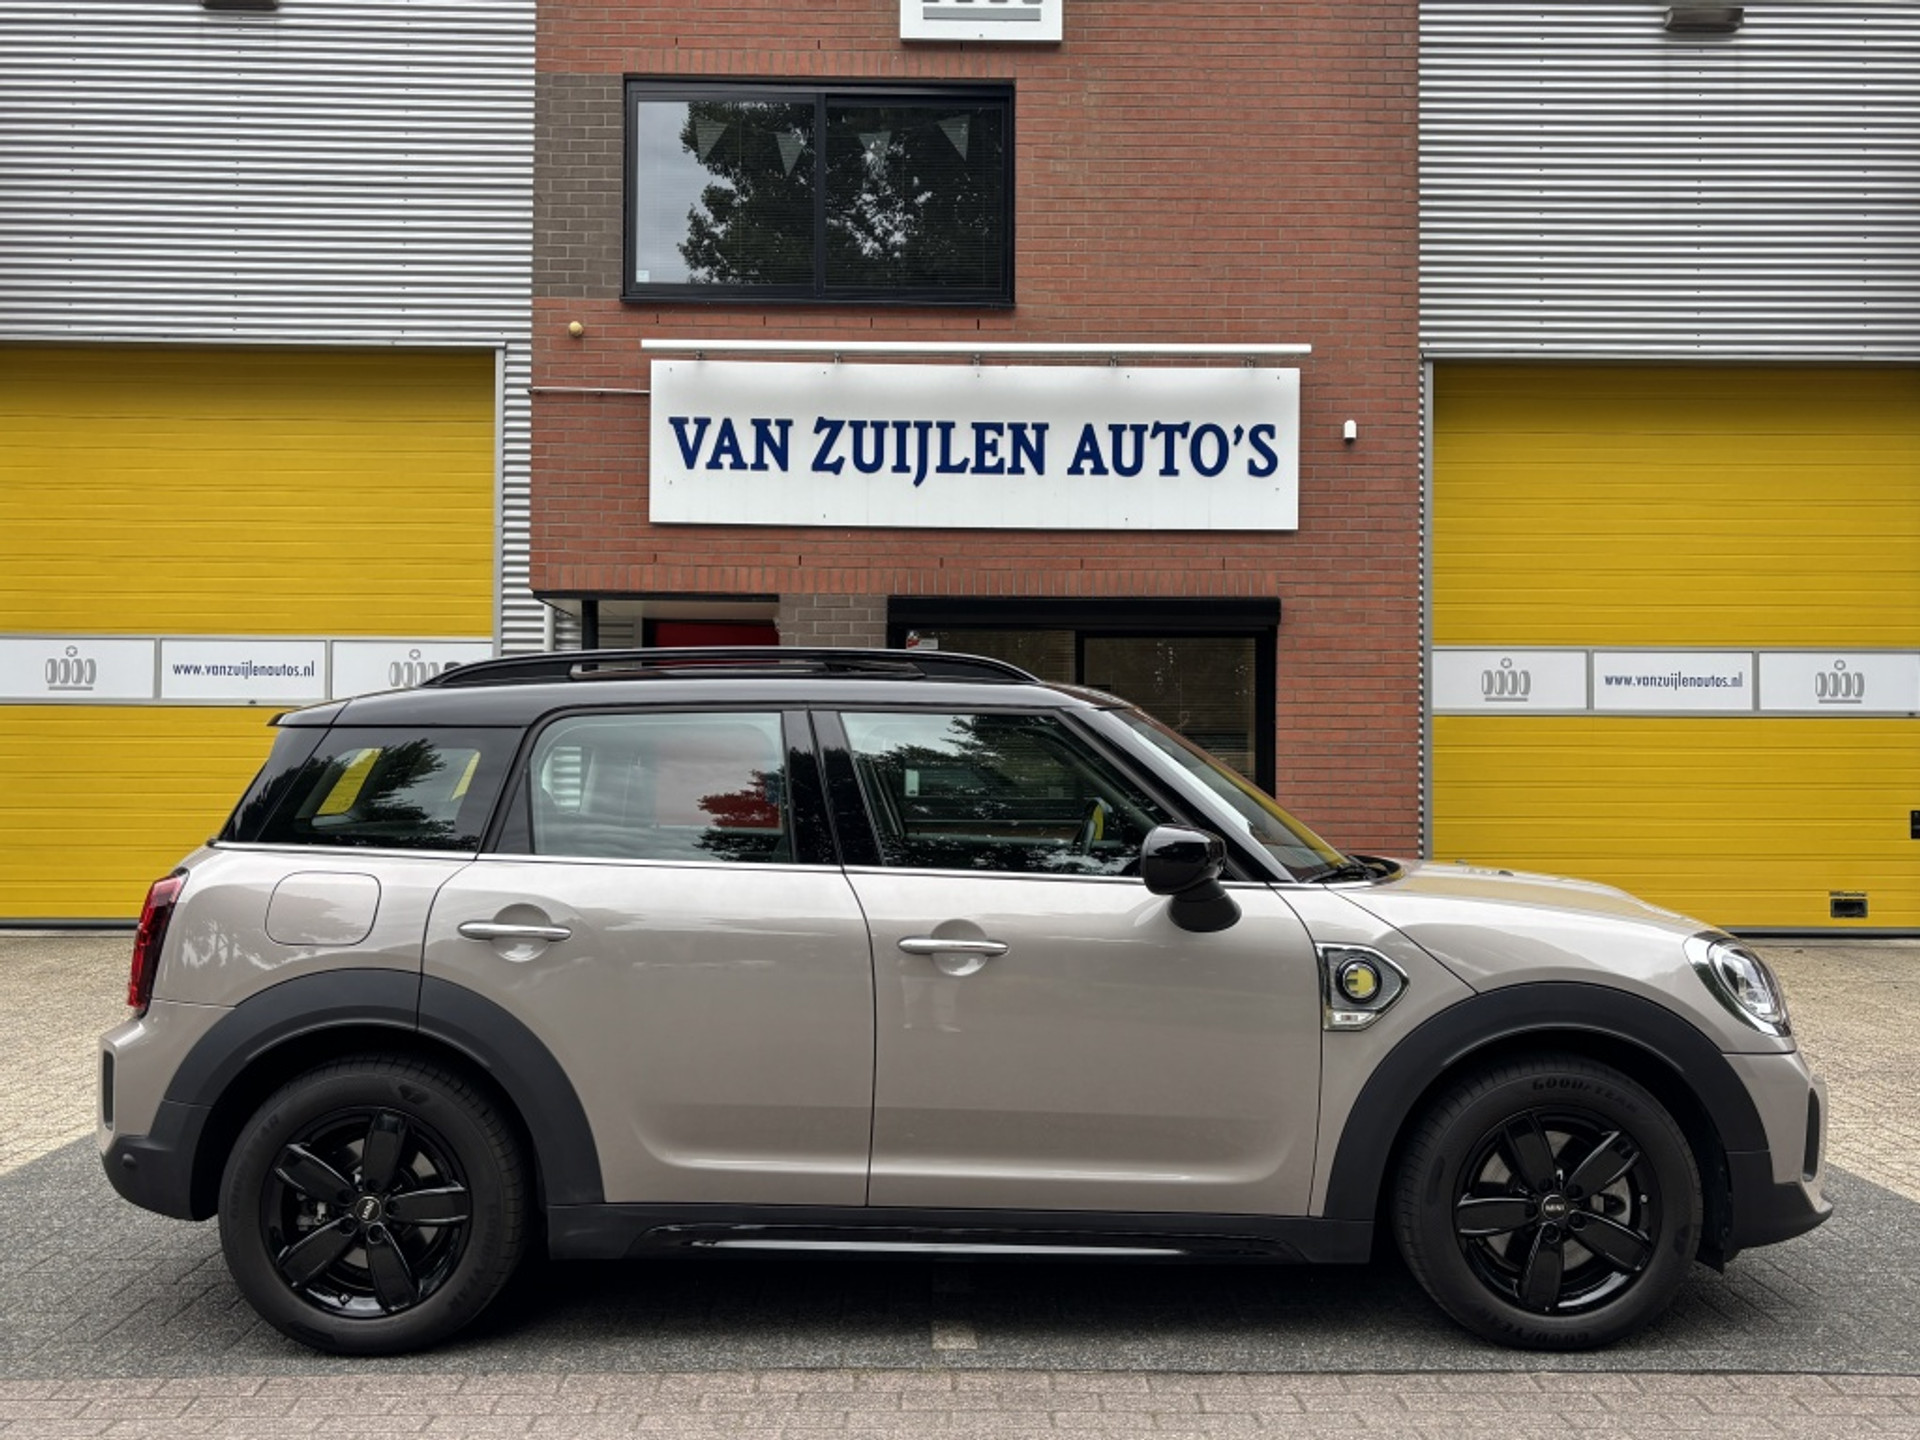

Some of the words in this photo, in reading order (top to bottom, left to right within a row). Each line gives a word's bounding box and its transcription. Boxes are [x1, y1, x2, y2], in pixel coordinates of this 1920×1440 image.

[669, 416, 794, 472] VAN
[811, 416, 1050, 487] ZUIJLEN
[1067, 420, 1279, 478] AUTO'S
[173, 660, 315, 680] www.vanzuijlenautos.nl
[1604, 671, 1743, 691] www.vanzuijlenautos.nl
